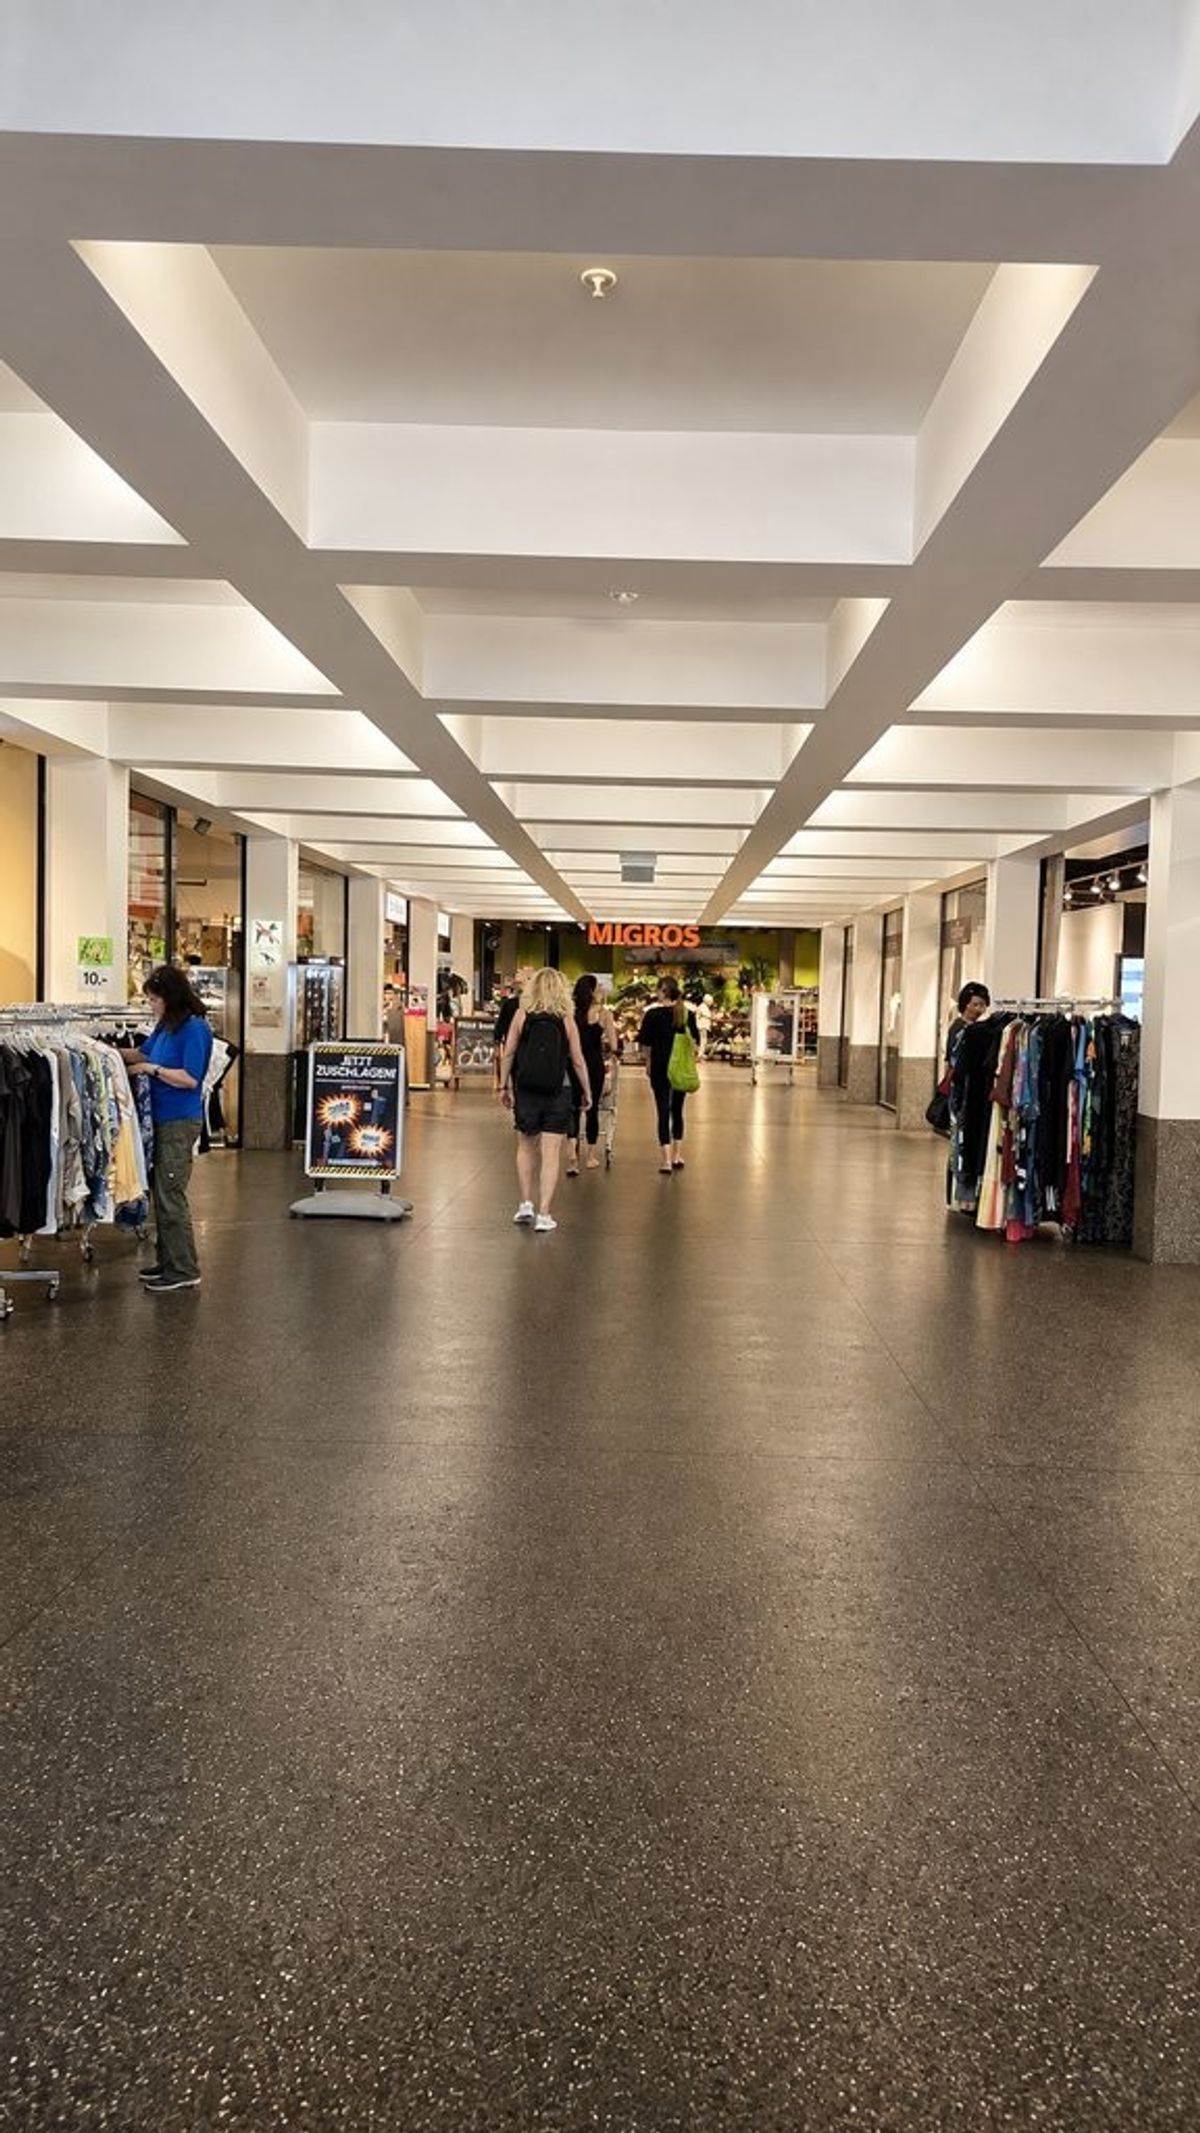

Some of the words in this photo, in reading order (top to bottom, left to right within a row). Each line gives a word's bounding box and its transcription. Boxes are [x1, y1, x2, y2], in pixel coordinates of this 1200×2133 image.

[588, 922, 702, 948] MIGROS
[83, 971, 108, 985] 10.-
[340, 1055, 372, 1066] JETZT
[316, 1064, 397, 1079] ZUSCHLAGEN!
